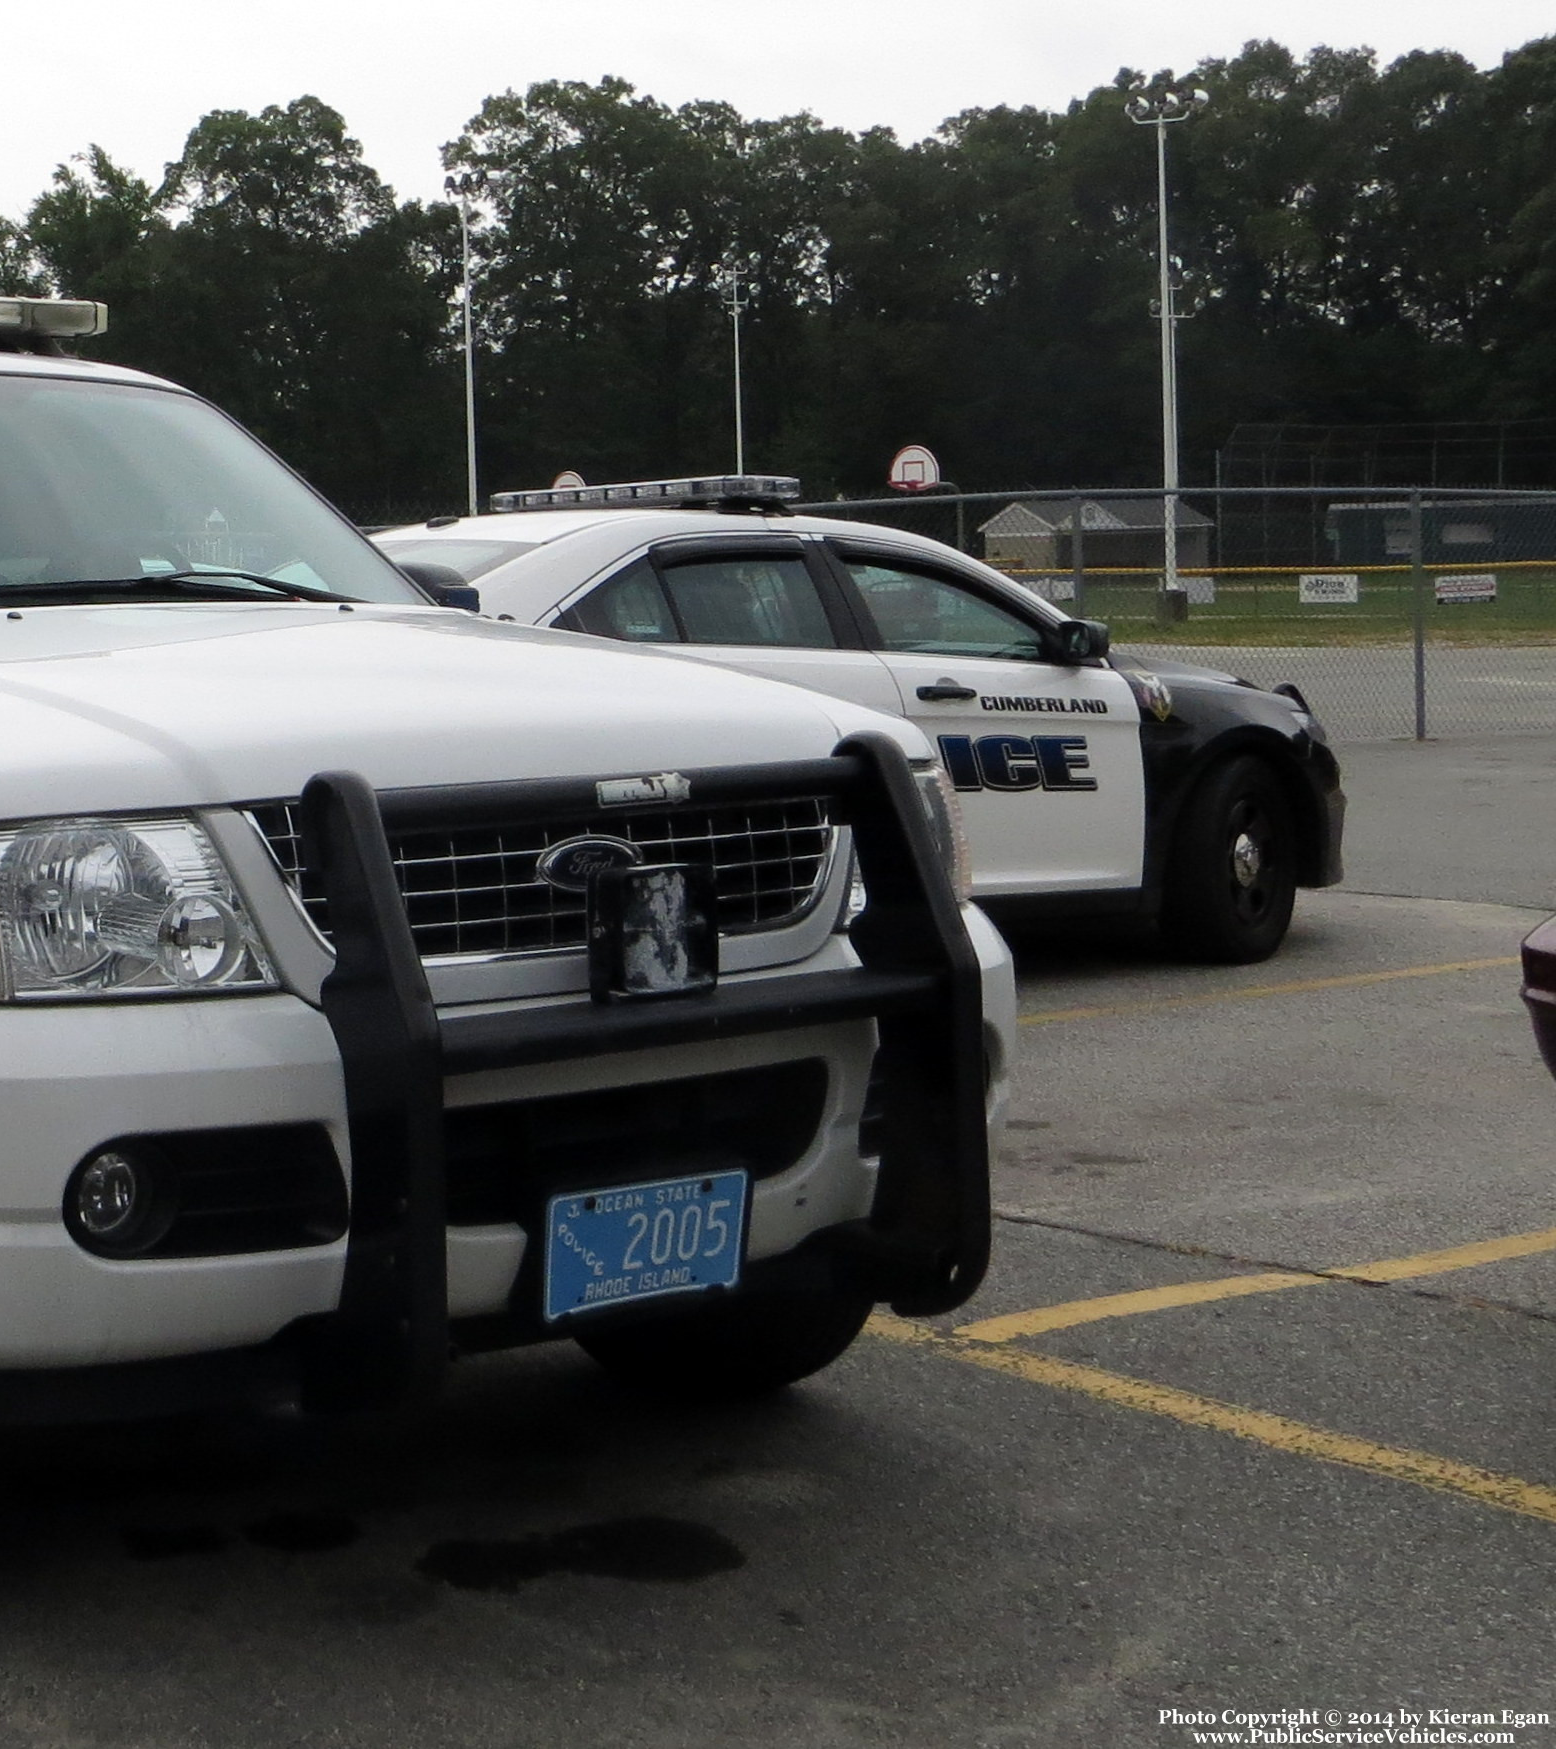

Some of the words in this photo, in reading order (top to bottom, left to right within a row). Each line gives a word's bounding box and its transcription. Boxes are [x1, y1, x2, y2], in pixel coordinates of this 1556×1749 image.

[980, 695, 1108, 715] CUMBERLAND
[568, 850, 616, 875] Ford
[594, 1193, 645, 1214] OCEAN
[655, 1184, 702, 1205] STATE
[557, 1223, 605, 1277] POLICE
[622, 1199, 731, 1271] 2005
[583, 1276, 633, 1302] RHODE
[637, 1266, 691, 1291] ISLAND
